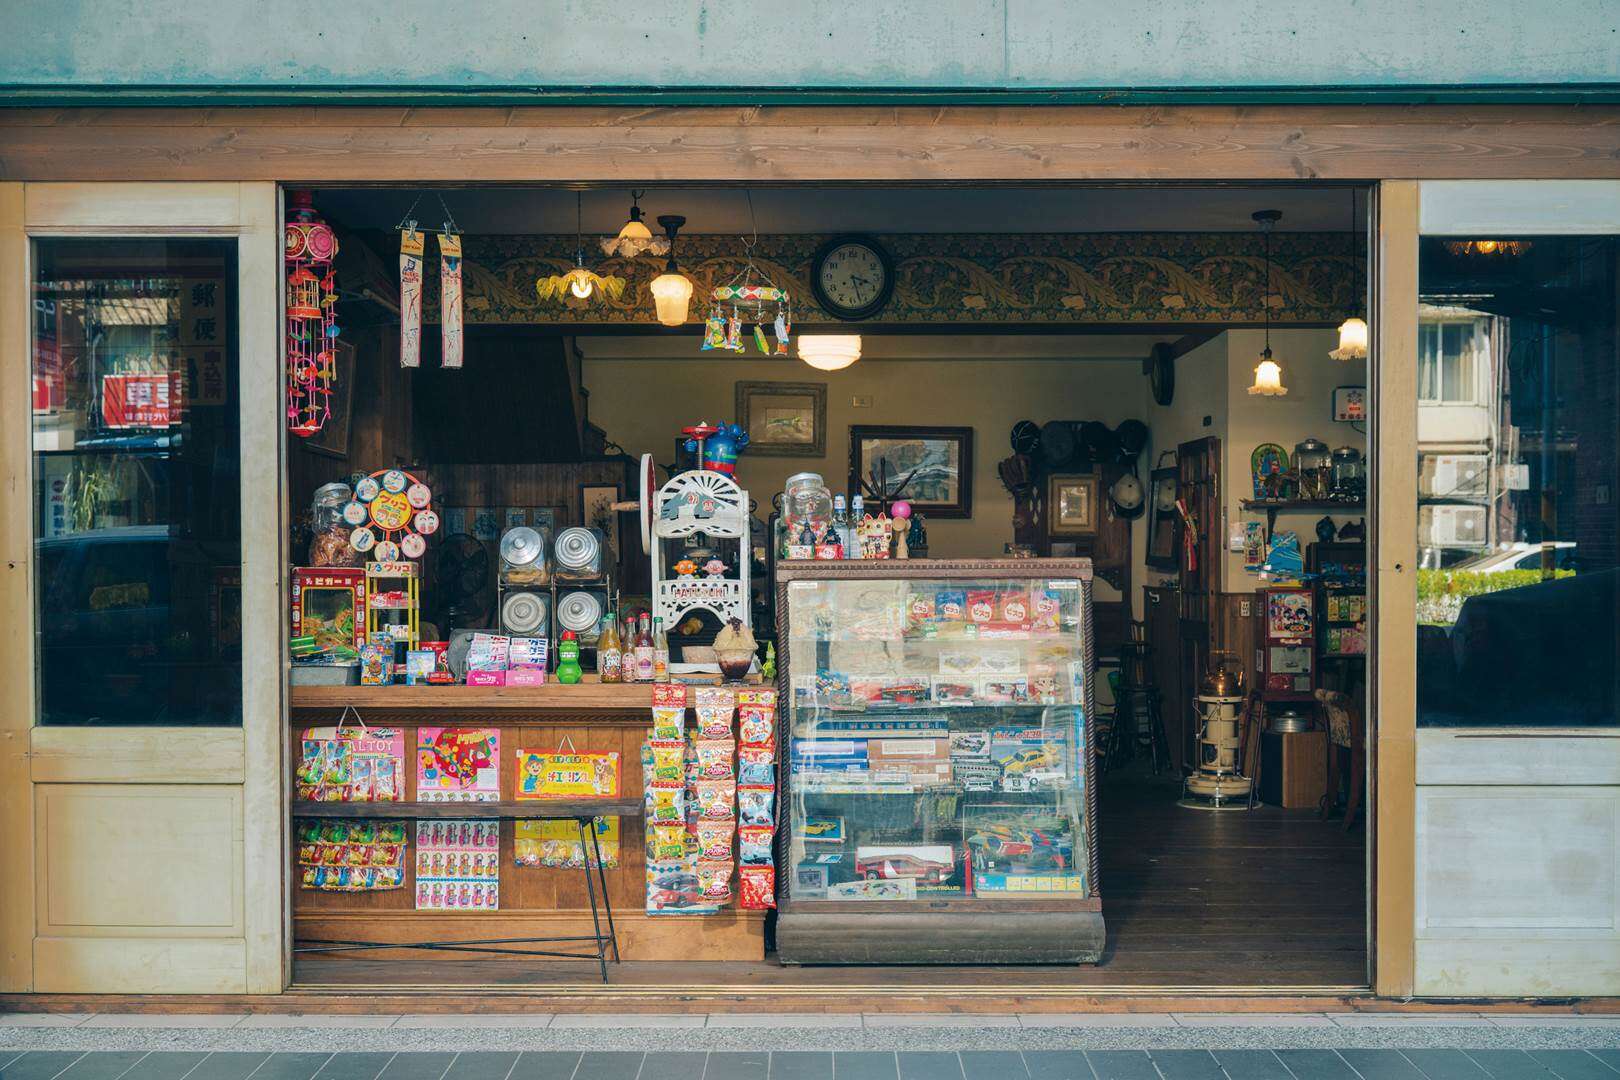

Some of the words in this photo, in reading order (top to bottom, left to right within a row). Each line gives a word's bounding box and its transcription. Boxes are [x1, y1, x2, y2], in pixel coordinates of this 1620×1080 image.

[192, 282, 216, 340] 郵便
[973, 608, 991, 618] ビスコ
[1006, 608, 1024, 618] ビスコ
[369, 740, 394, 752] TOY
